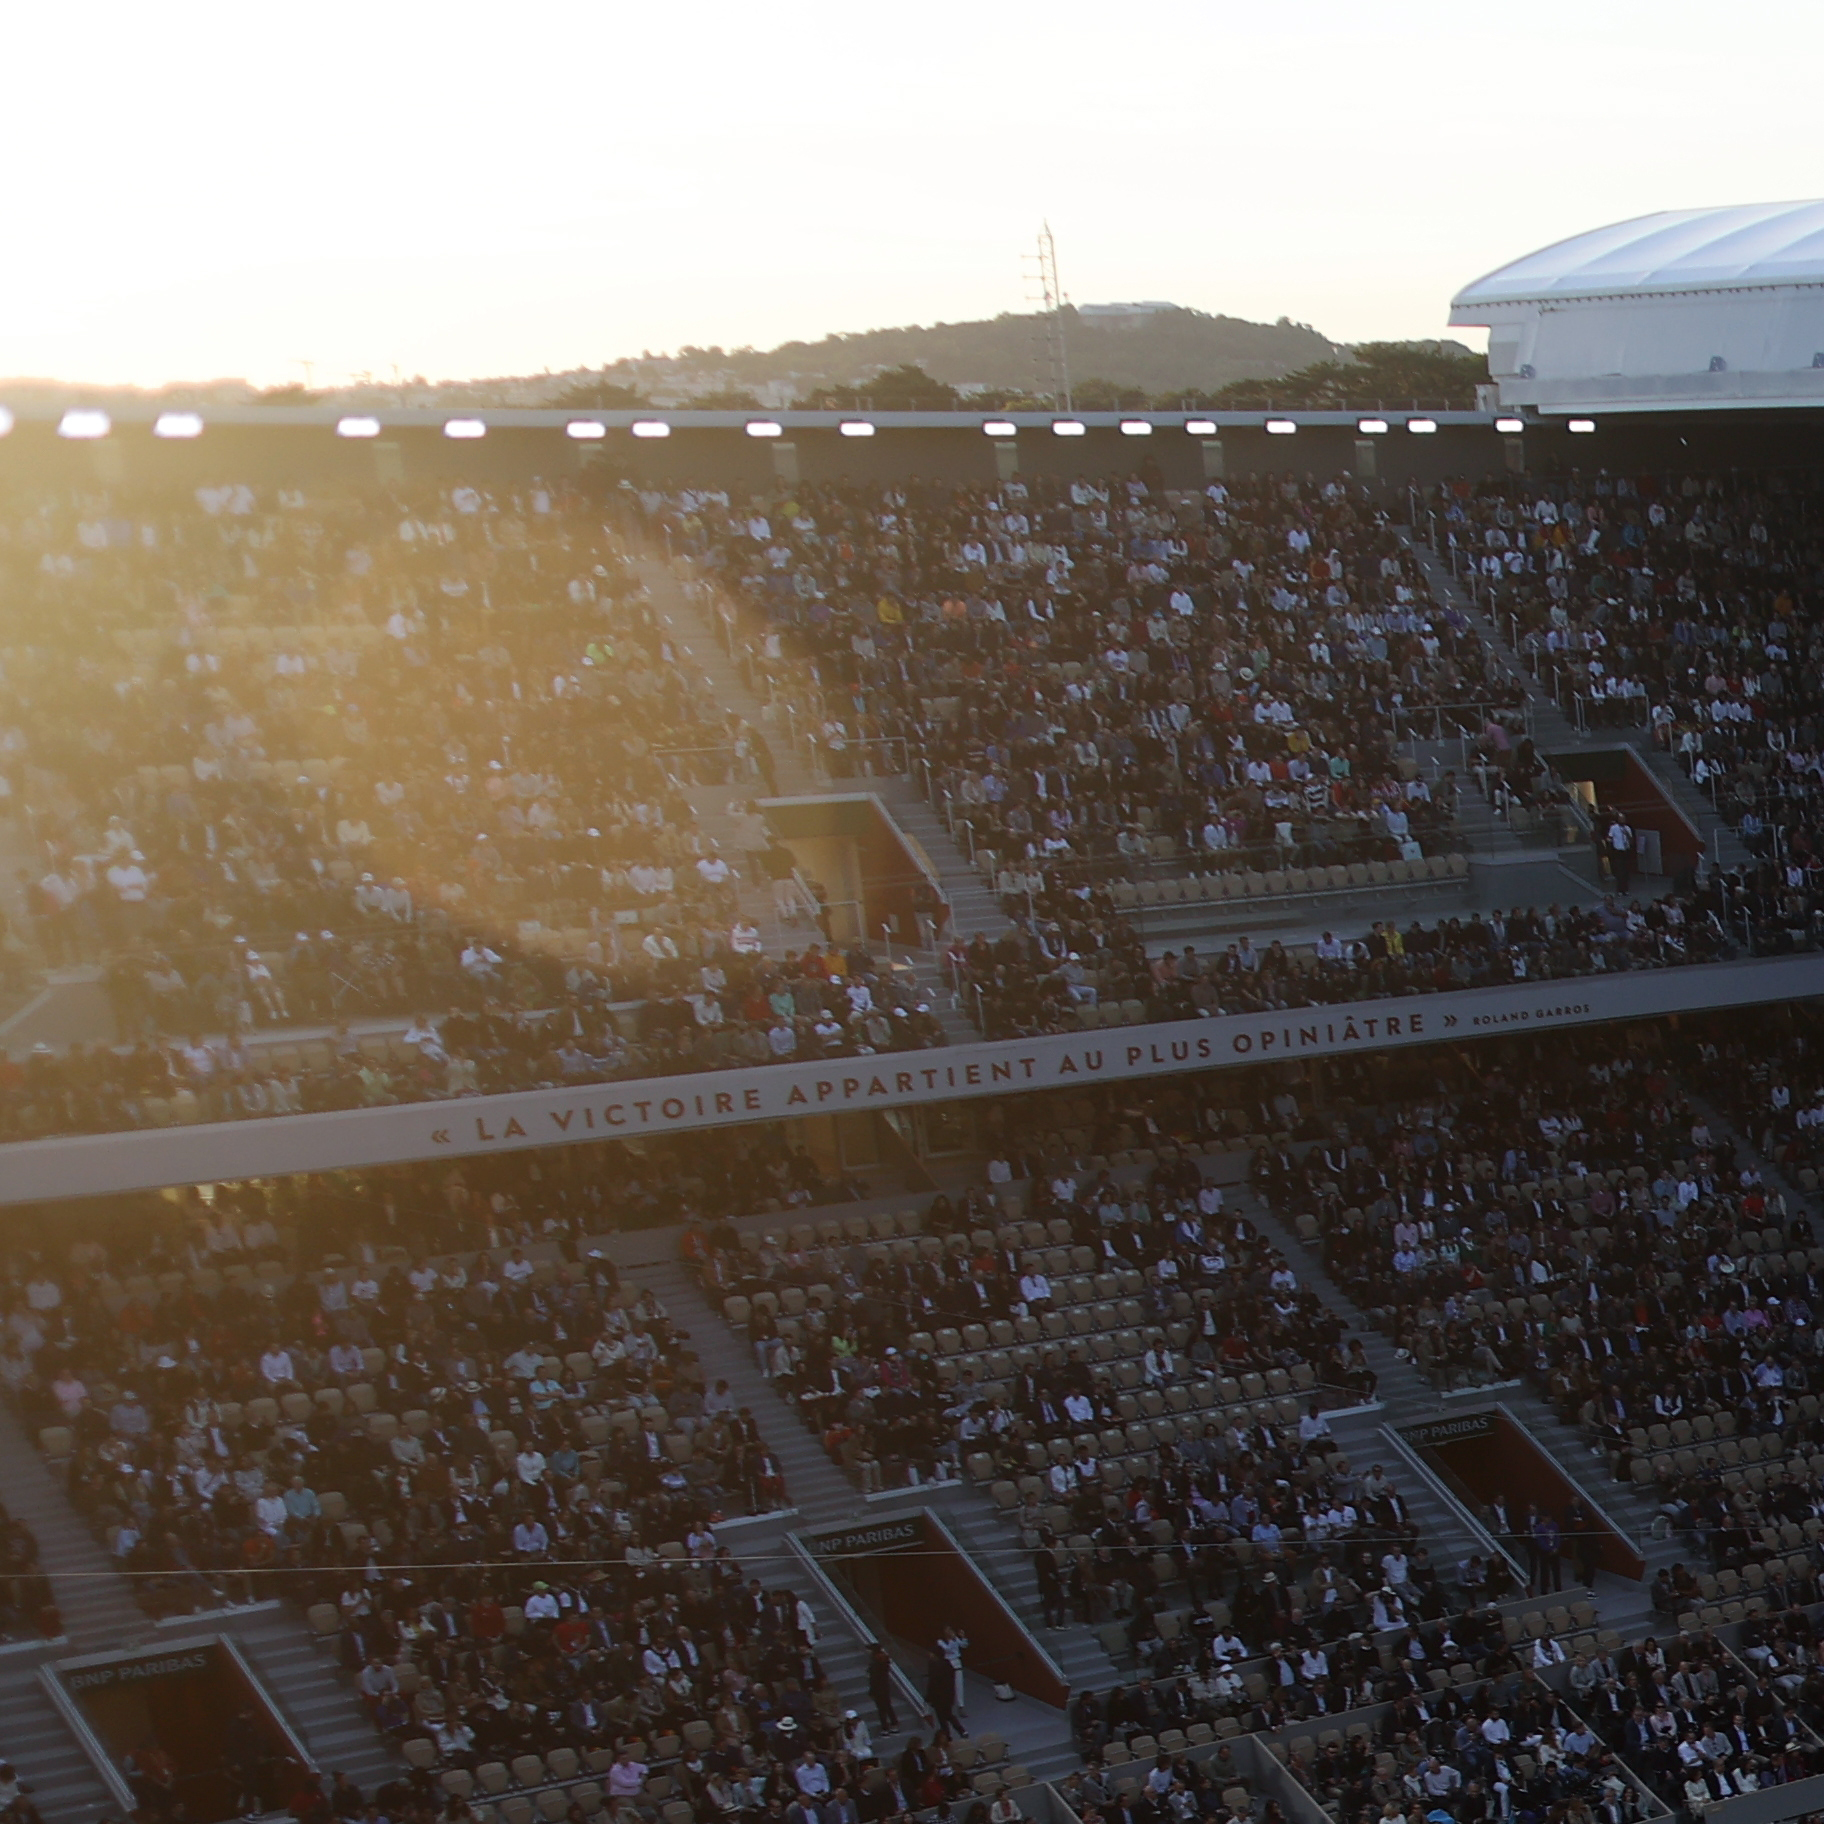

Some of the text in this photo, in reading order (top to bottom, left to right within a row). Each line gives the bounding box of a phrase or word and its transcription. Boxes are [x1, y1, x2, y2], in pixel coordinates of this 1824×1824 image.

[1473, 1004, 1590, 1025] ROLAND GARROS
[476, 1117, 527, 1142] LA
[550, 1089, 760, 1132] VICTOIRE
[788, 1058, 1036, 1104] APPARTIENT
[1059, 1050, 1103, 1075] AU
[1126, 1038, 1211, 1066] PLUS
[1232, 1014, 1424, 1053] OPINIÂTRE
[1431, 1417, 1488, 1438] PARIBAS
[845, 1524, 914, 1547] PARIBAS
[69, 1653, 207, 1689] BNP PARIBAS
